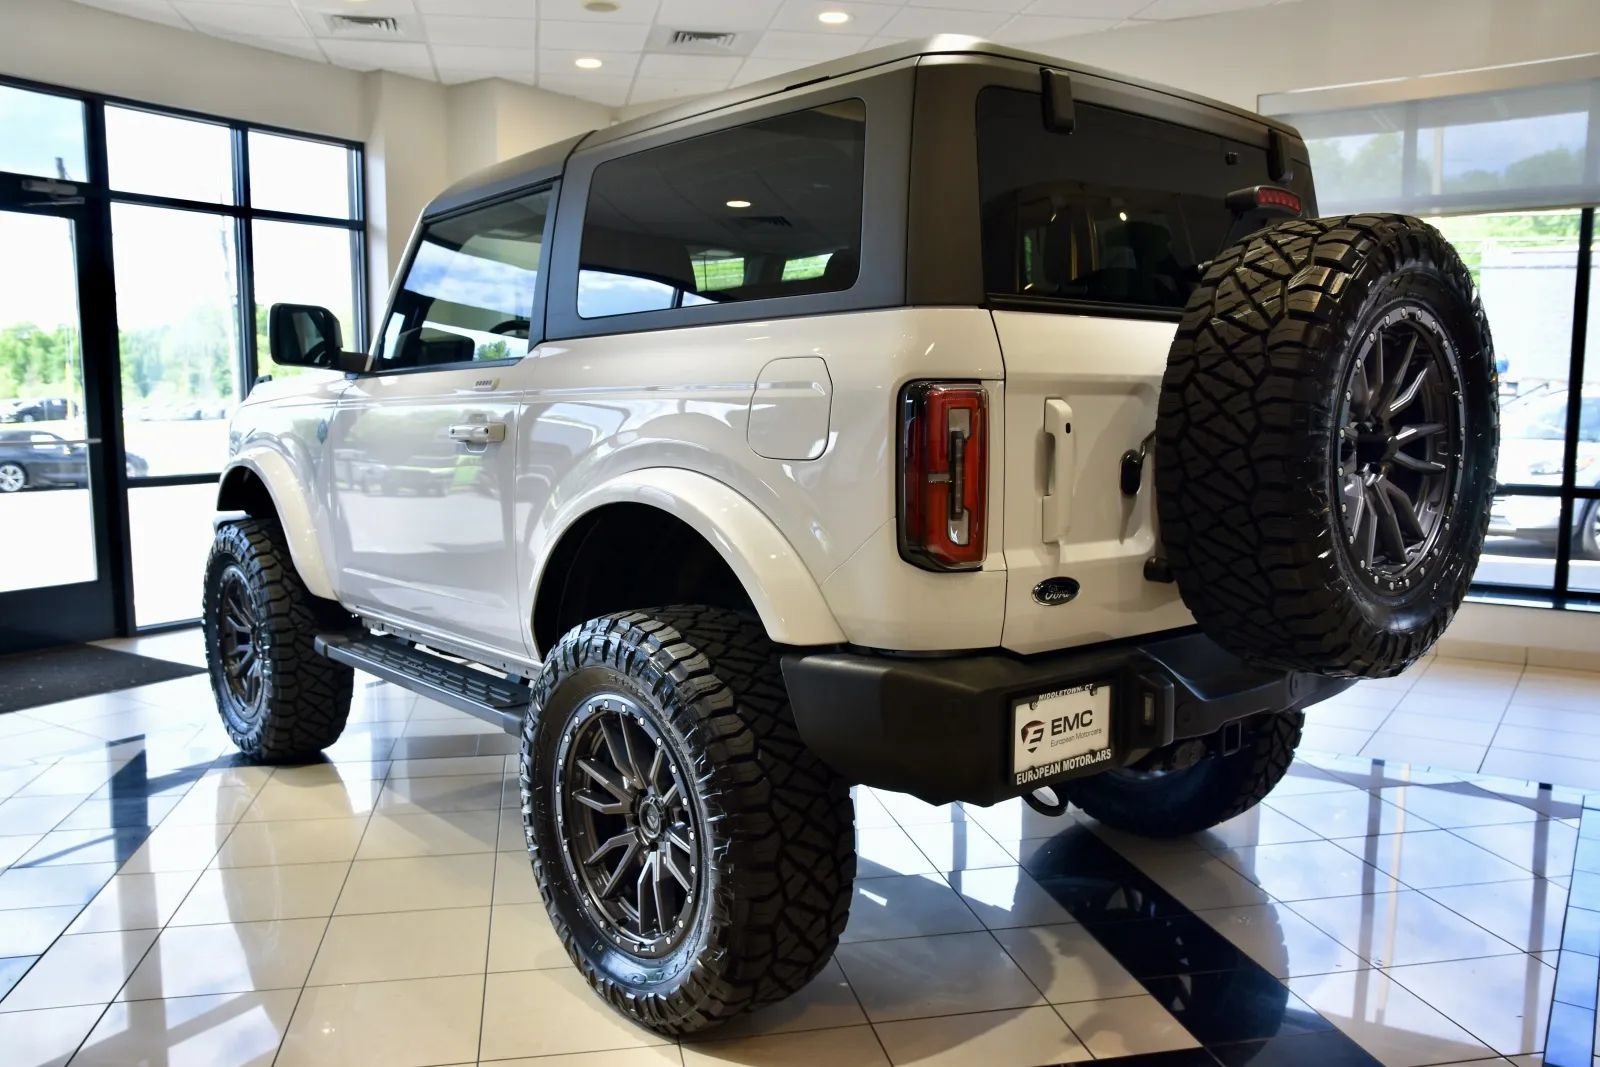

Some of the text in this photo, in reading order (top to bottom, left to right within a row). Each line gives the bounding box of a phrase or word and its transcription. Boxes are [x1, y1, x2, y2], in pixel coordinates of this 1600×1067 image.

[1085, 683, 1094, 691] CT
[1051, 709, 1093, 736] EMC
[1051, 727, 1102, 748] European Motorcars
[1016, 748, 1111, 786] EUROPEAN MOTORCARS
